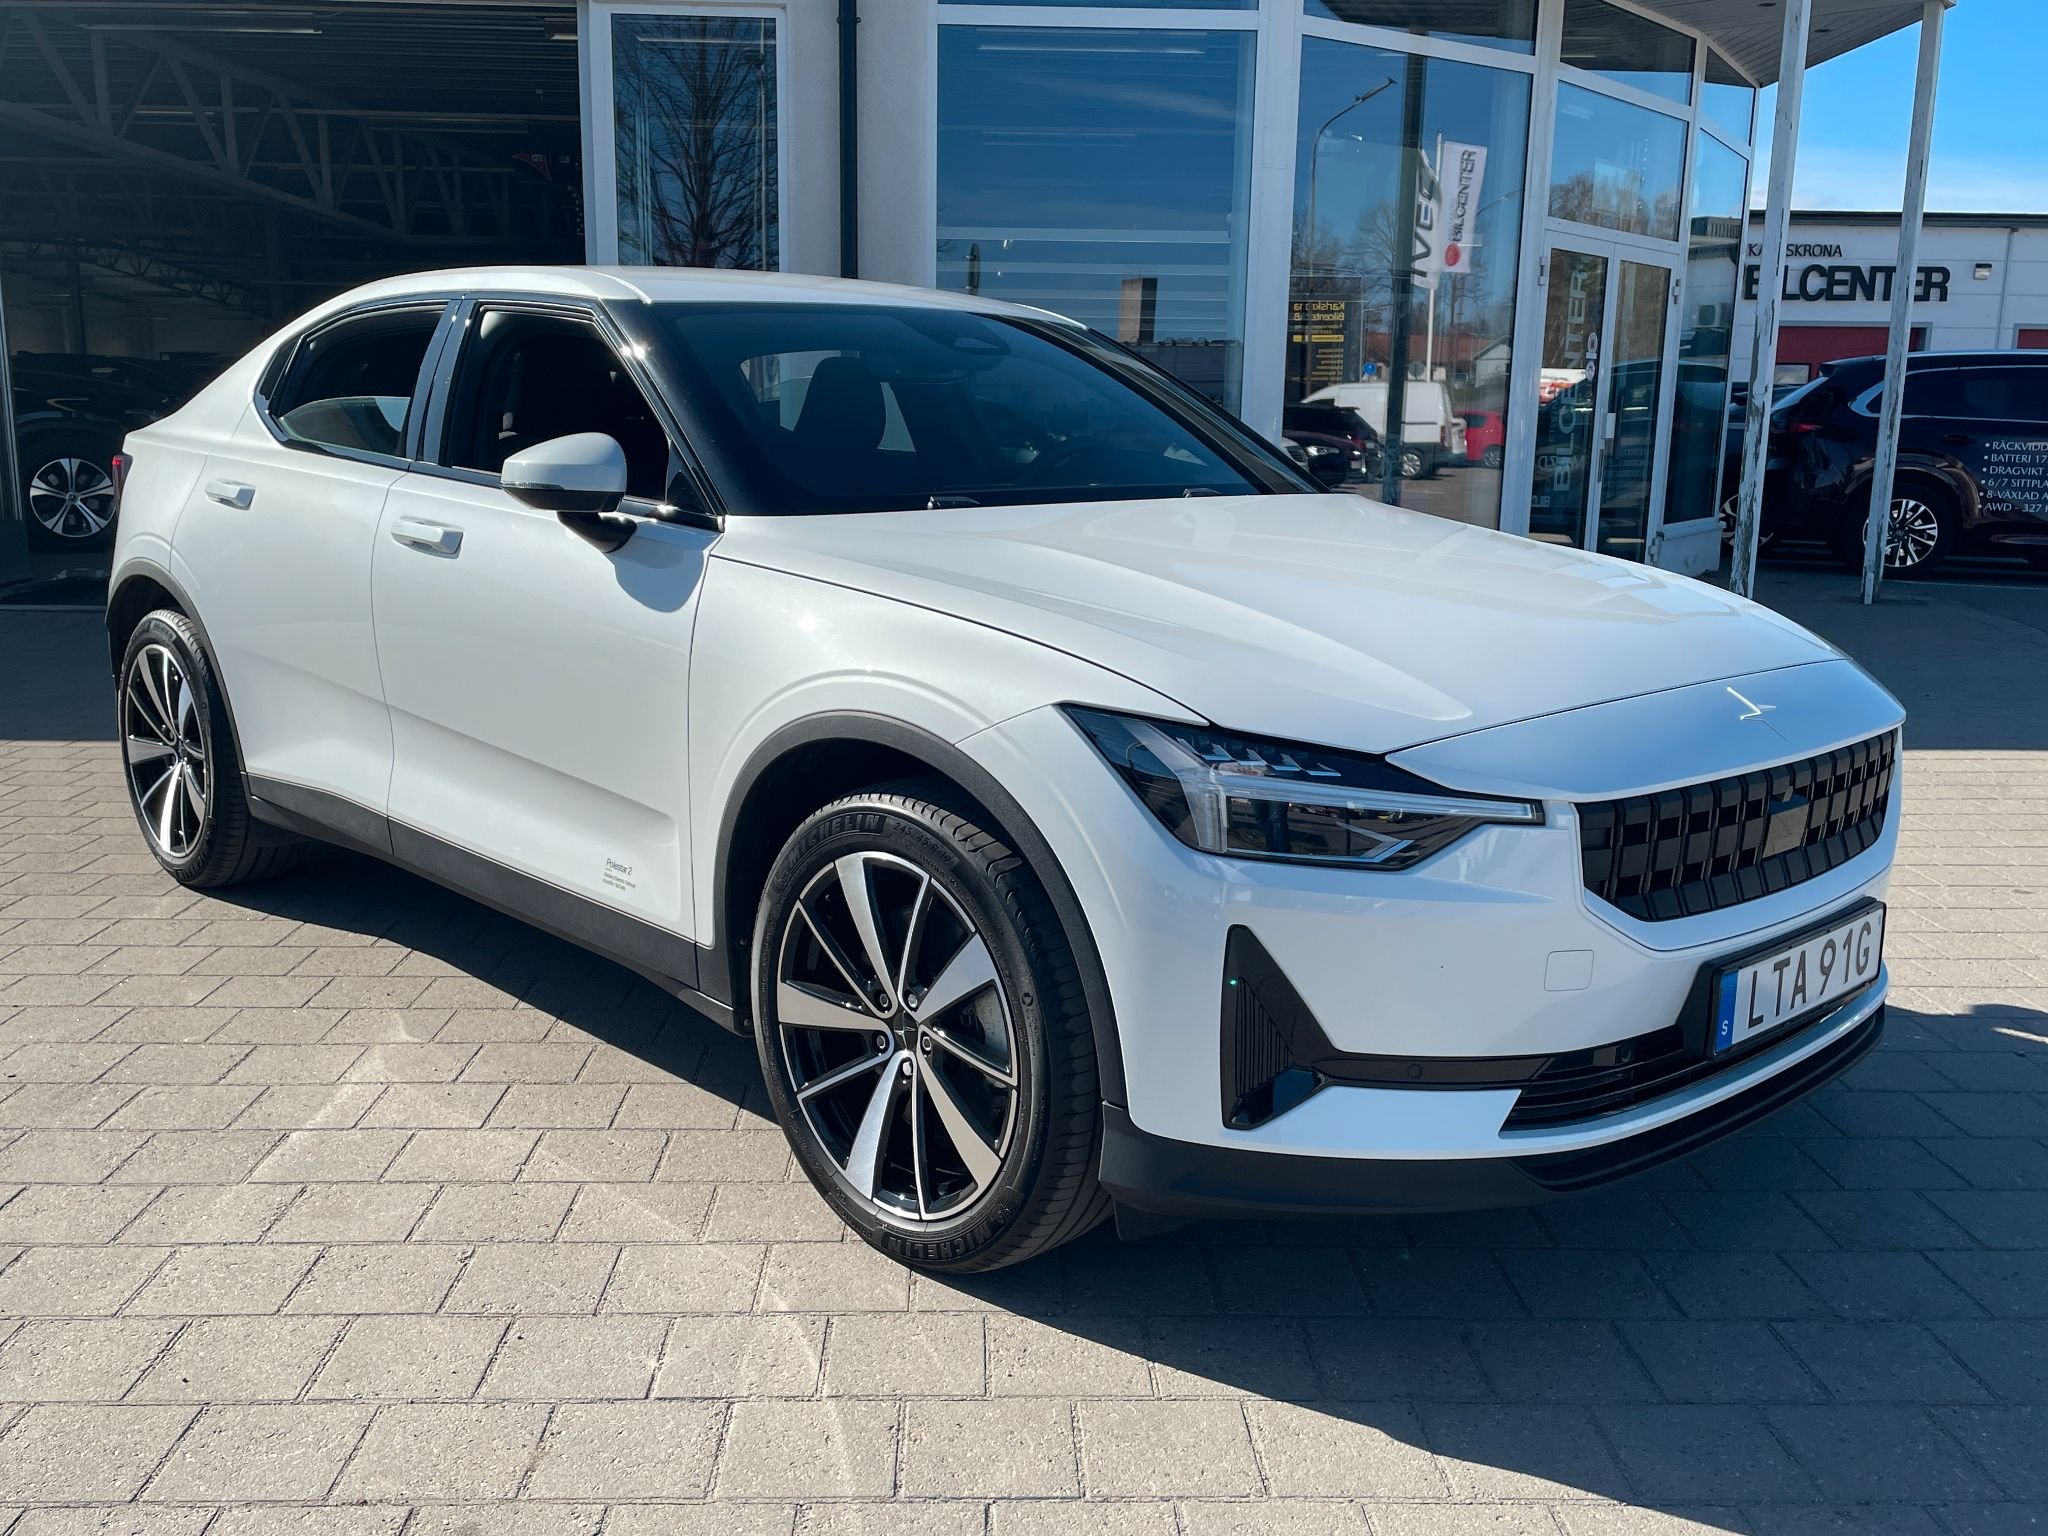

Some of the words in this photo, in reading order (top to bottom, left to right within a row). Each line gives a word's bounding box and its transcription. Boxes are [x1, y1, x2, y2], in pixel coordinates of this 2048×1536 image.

[1452, 149, 1477, 242] BILCENTER
[1748, 243, 1842, 257] KSKRONA
[1744, 264, 1950, 302] BLCENTR
[1991, 453, 2031, 463] BATTERI
[1989, 465, 2044, 476] DRAGVIKT
[1988, 478, 2008, 488] 6/7
[1984, 502, 2012, 512] AWD
[2022, 503, 2042, 513] 327
[788, 814, 880, 865] MICHELIN
[893, 822, 930, 847] 245/45
[1721, 1019, 1729, 1036] S
[887, 1224, 994, 1260] MICHELIN
